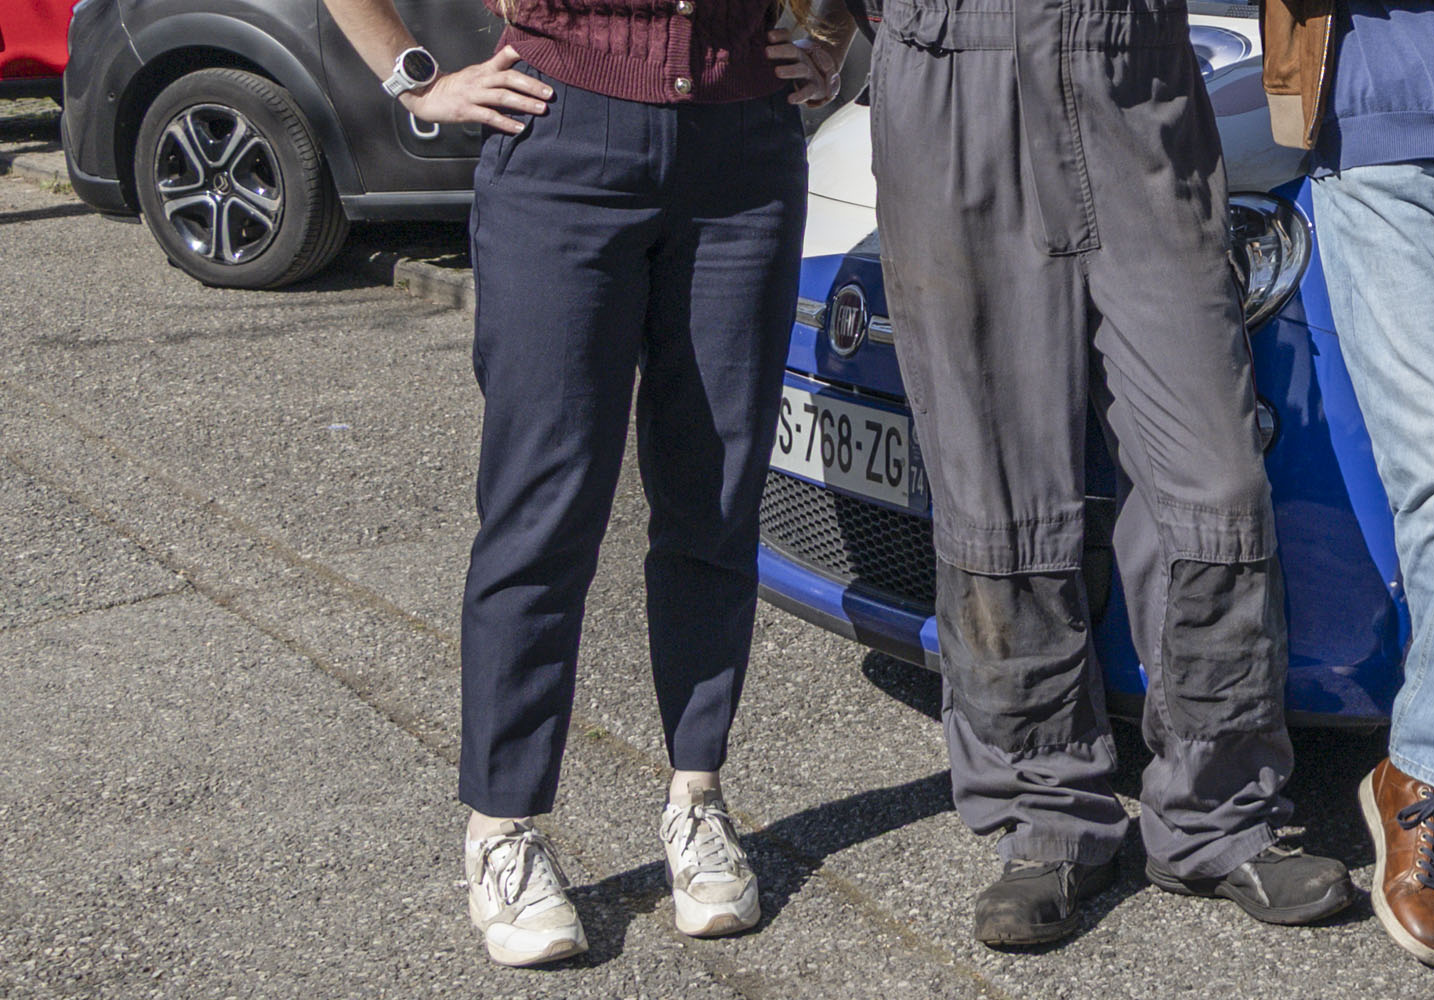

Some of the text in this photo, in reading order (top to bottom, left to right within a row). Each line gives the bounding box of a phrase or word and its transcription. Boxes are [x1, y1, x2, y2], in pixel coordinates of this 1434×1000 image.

[838, 305, 859, 336] FIAT
[779, 396, 903, 488] S-768-ZG
[910, 465, 924, 496] 74
